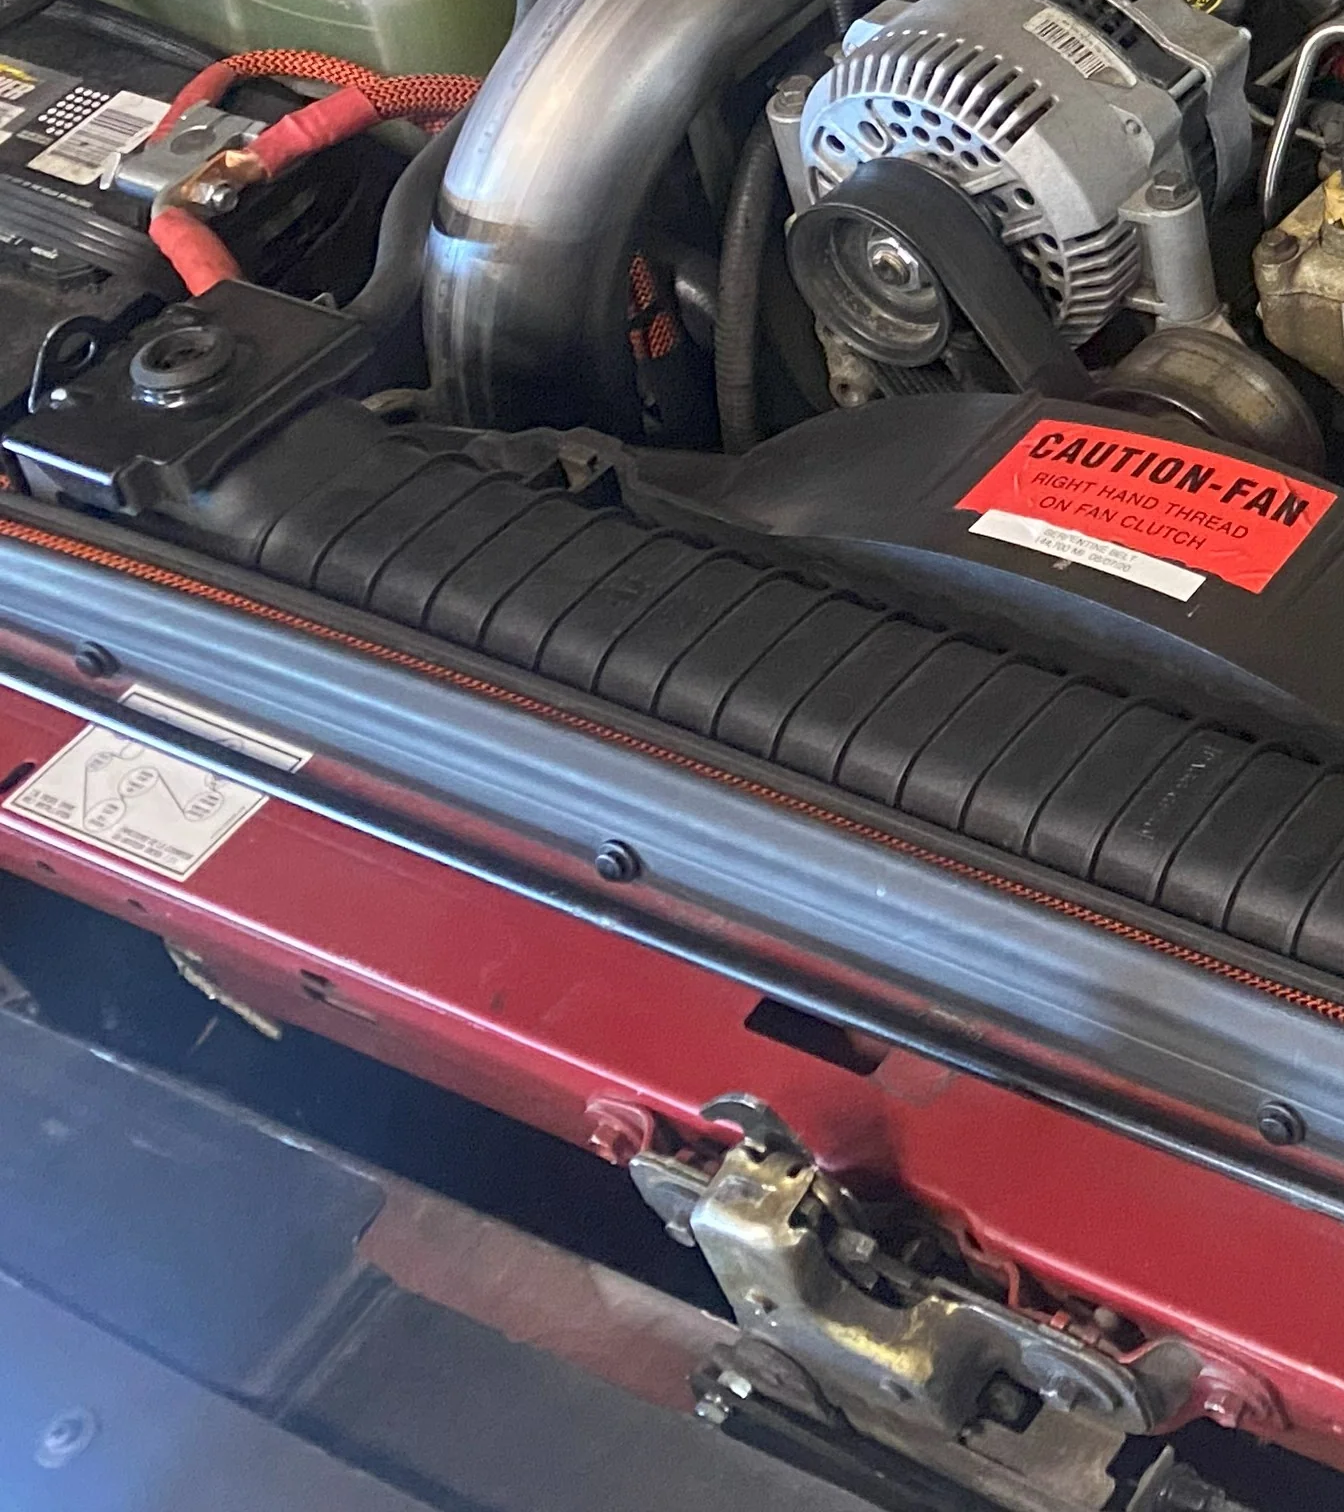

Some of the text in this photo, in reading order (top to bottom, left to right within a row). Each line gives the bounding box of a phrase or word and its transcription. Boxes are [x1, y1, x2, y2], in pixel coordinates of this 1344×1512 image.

[1029, 433, 1309, 528] CAUTION-FAN
[1031, 472, 1249, 539] RIGHT HAND THREAD
[1039, 496, 1207, 550] ON FAN CLUTCH
[1043, 528, 1137, 562] SERPENTINE BELT
